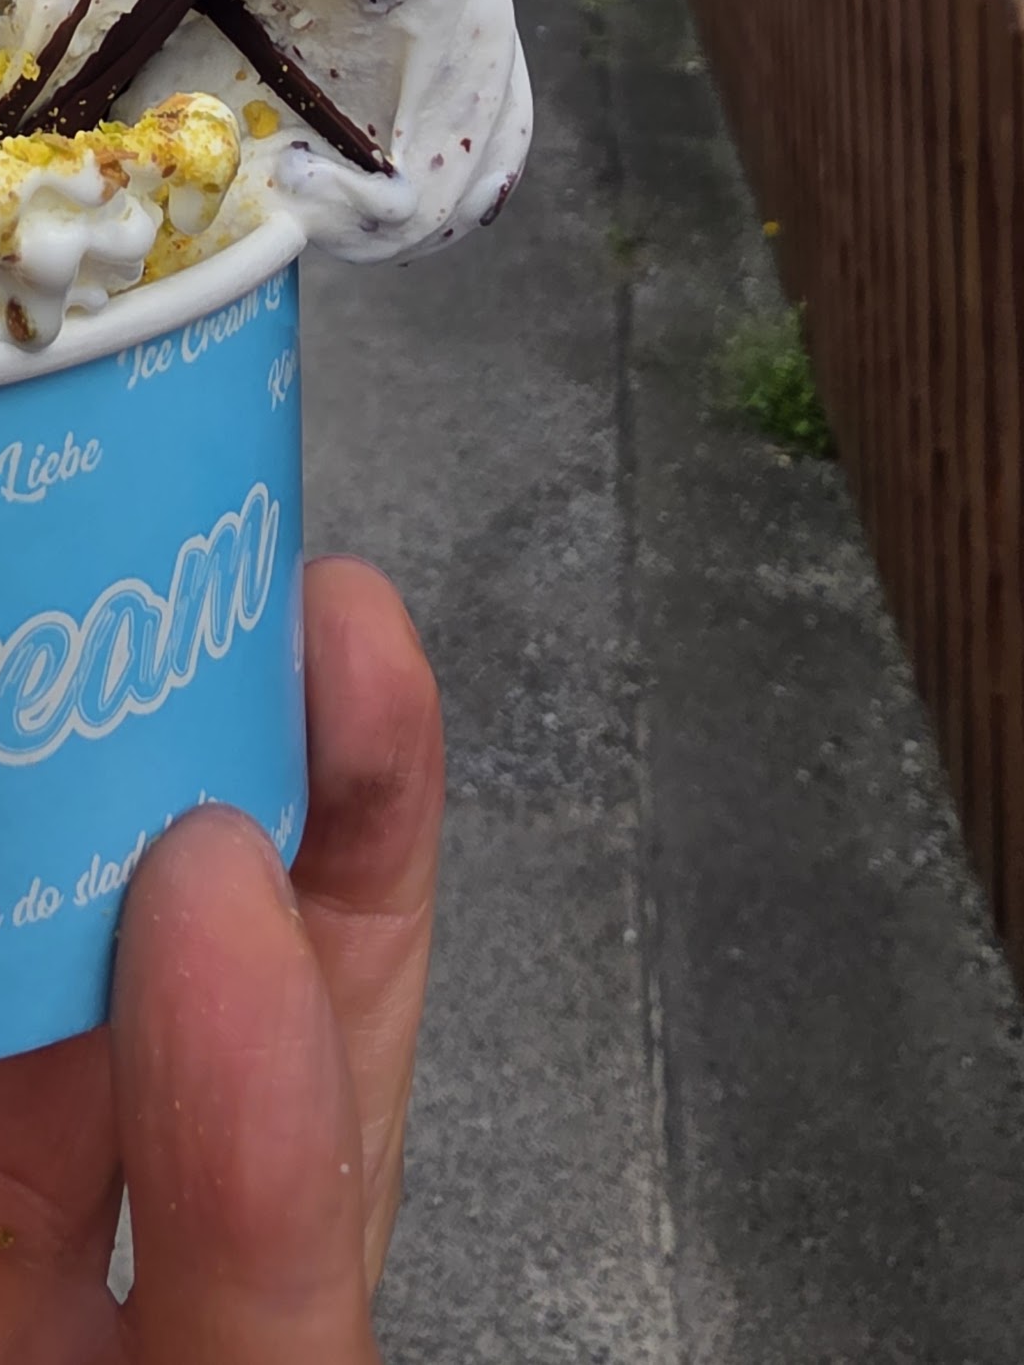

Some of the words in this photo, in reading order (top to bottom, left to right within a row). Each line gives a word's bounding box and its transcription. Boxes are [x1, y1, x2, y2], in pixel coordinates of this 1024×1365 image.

[117, 338, 175, 389] Ice
[181, 289, 260, 364] Cream
[13, 876, 65, 920] do
